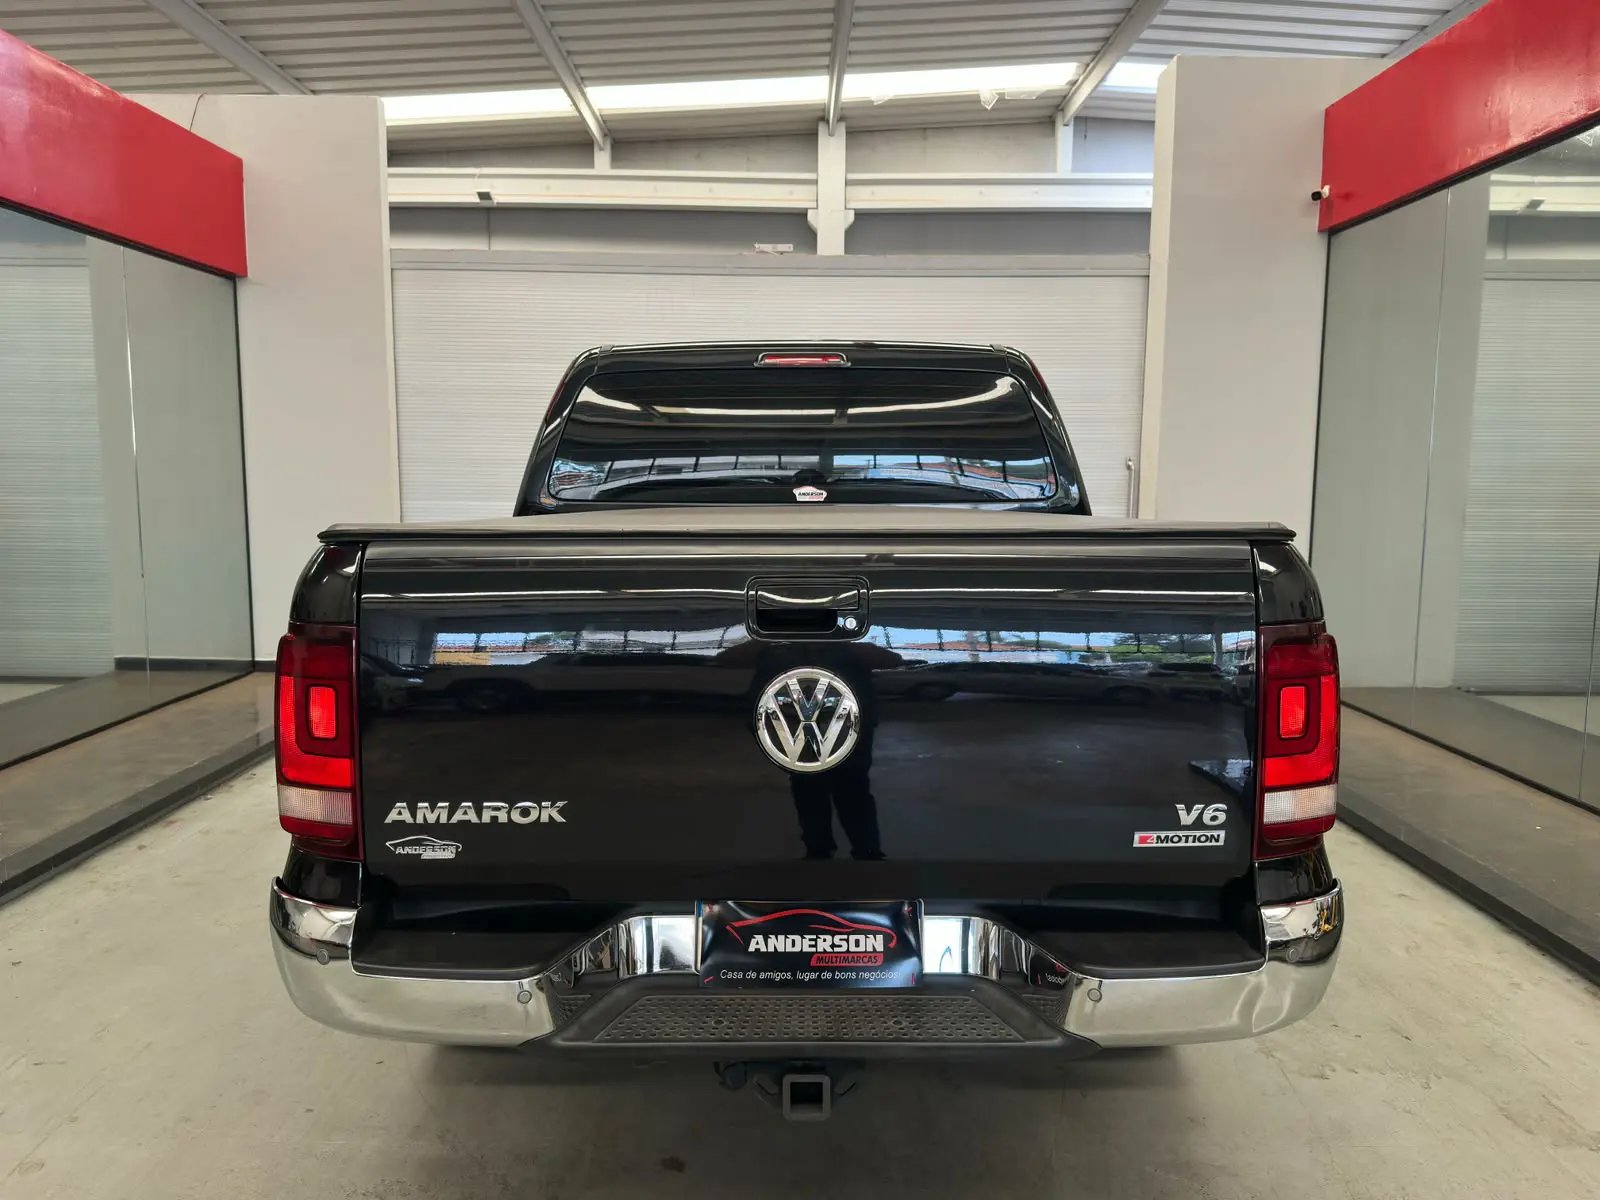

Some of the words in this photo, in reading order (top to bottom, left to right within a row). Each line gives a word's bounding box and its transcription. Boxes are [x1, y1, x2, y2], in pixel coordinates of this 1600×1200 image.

[384, 801, 568, 824] AMAROK
[1175, 803, 1228, 826] V6
[748, 934, 883, 952] ANDERSON
[815, 955, 878, 965] MULTIMARCAS
[720, 969, 743, 979] Casa
[745, 970, 757, 979] de
[759, 970, 793, 981] amigos,
[796, 970, 819, 981] lugar
[821, 970, 832, 979] de
[834, 970, 856, 979] bons
